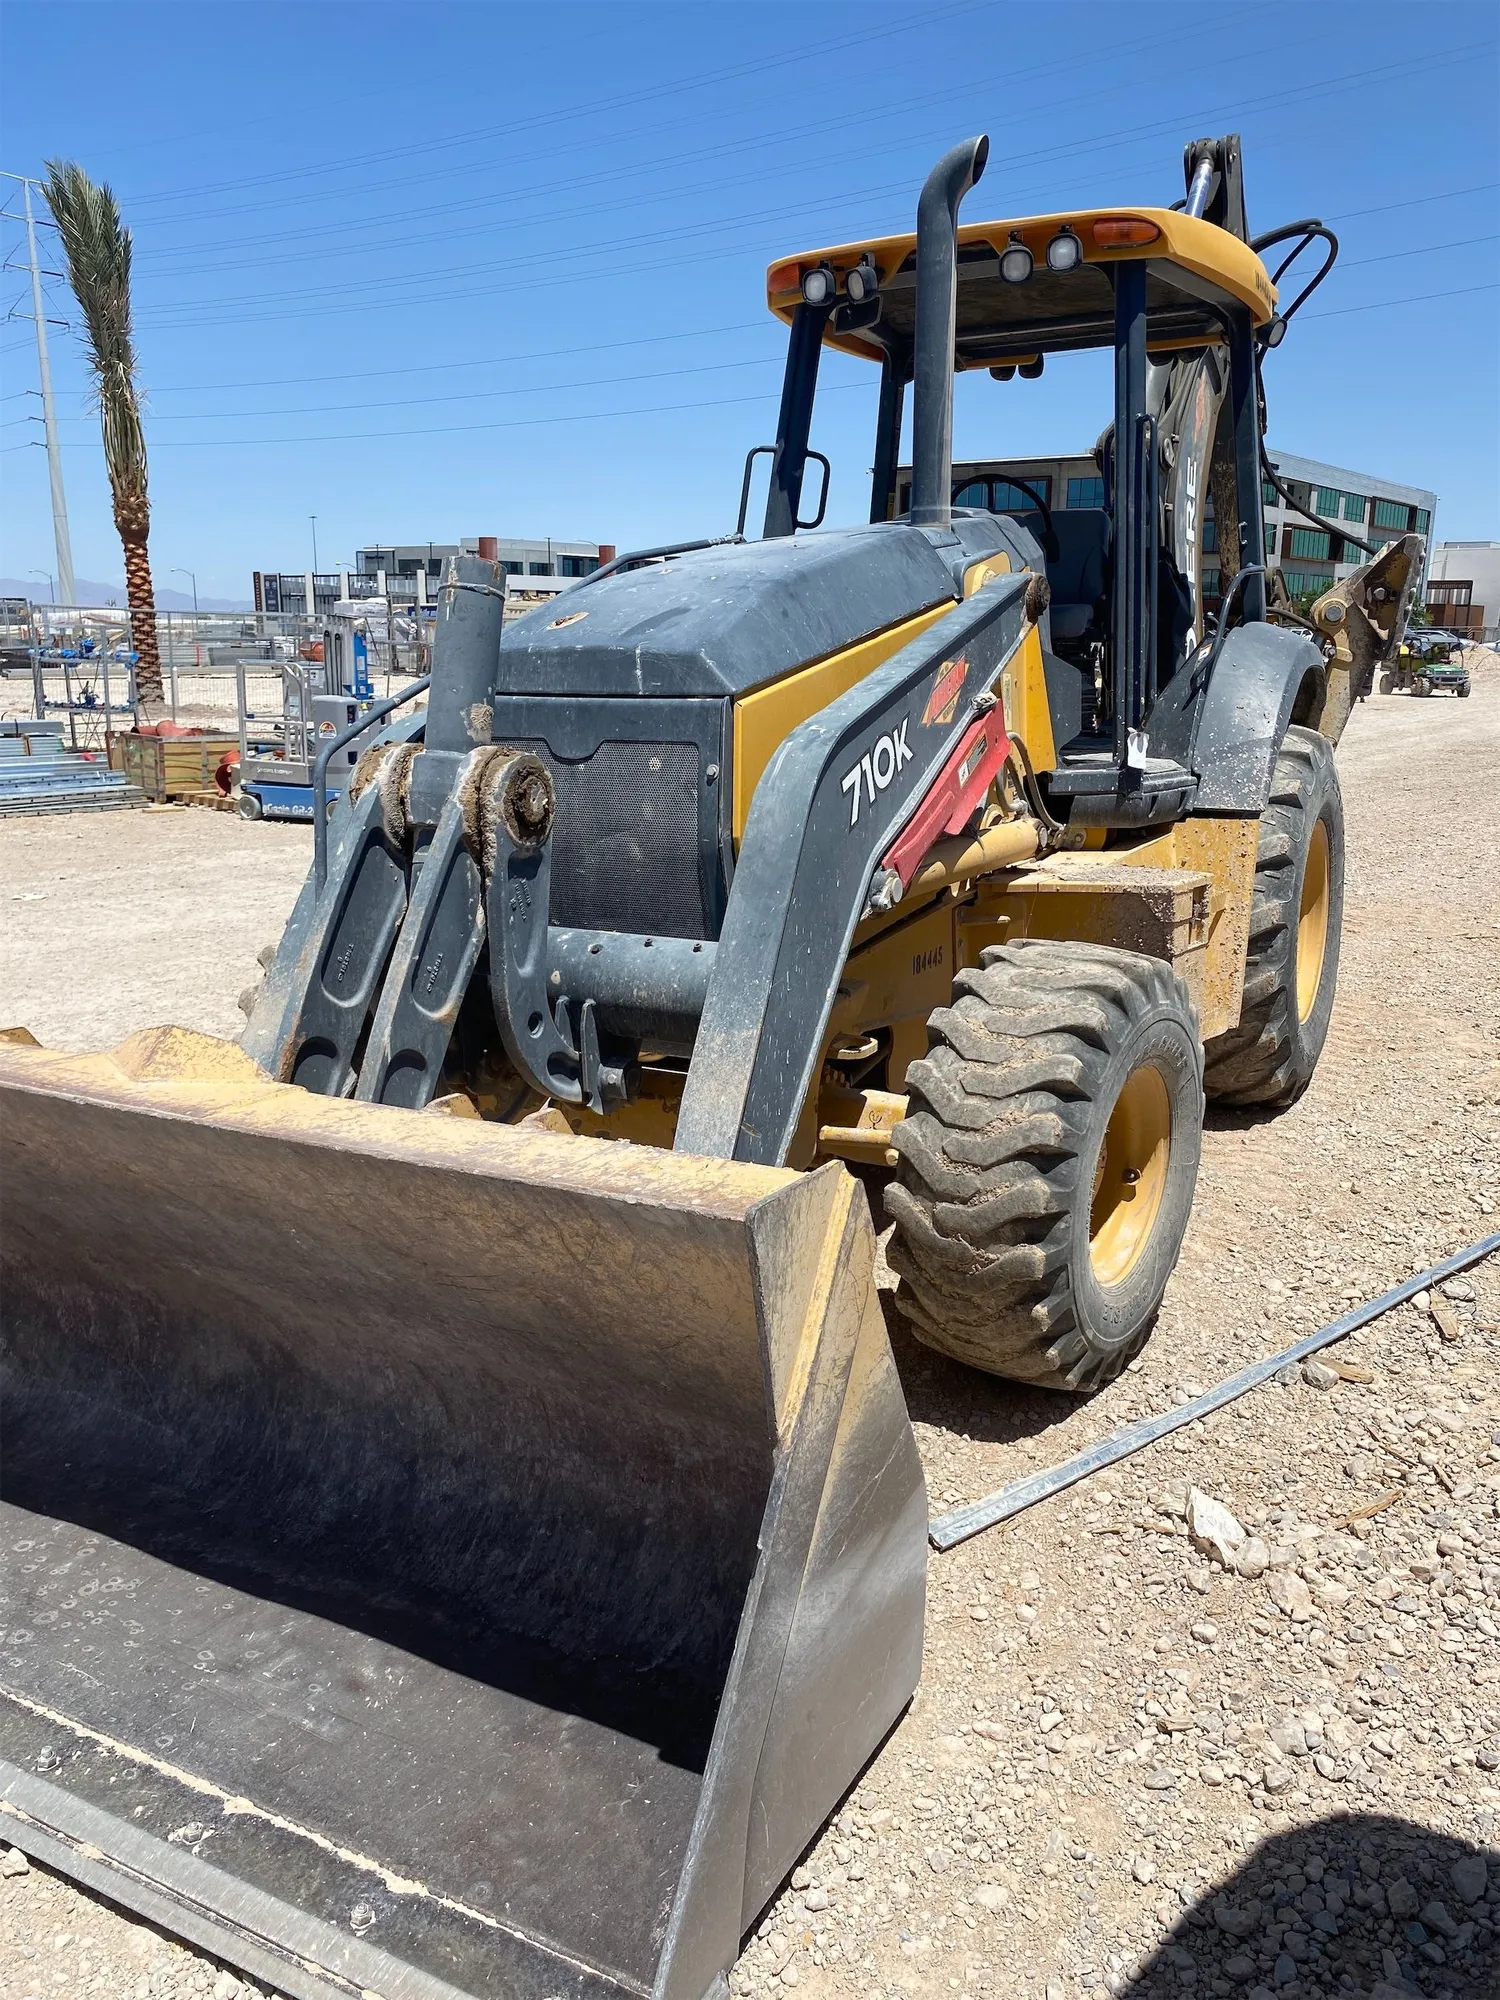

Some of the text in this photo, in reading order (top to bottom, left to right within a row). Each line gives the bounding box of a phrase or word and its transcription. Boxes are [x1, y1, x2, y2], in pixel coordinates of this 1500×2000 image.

[1186, 456, 1197, 661] DERE
[841, 717, 914, 827] 710K
[912, 945, 944, 976] 184445
